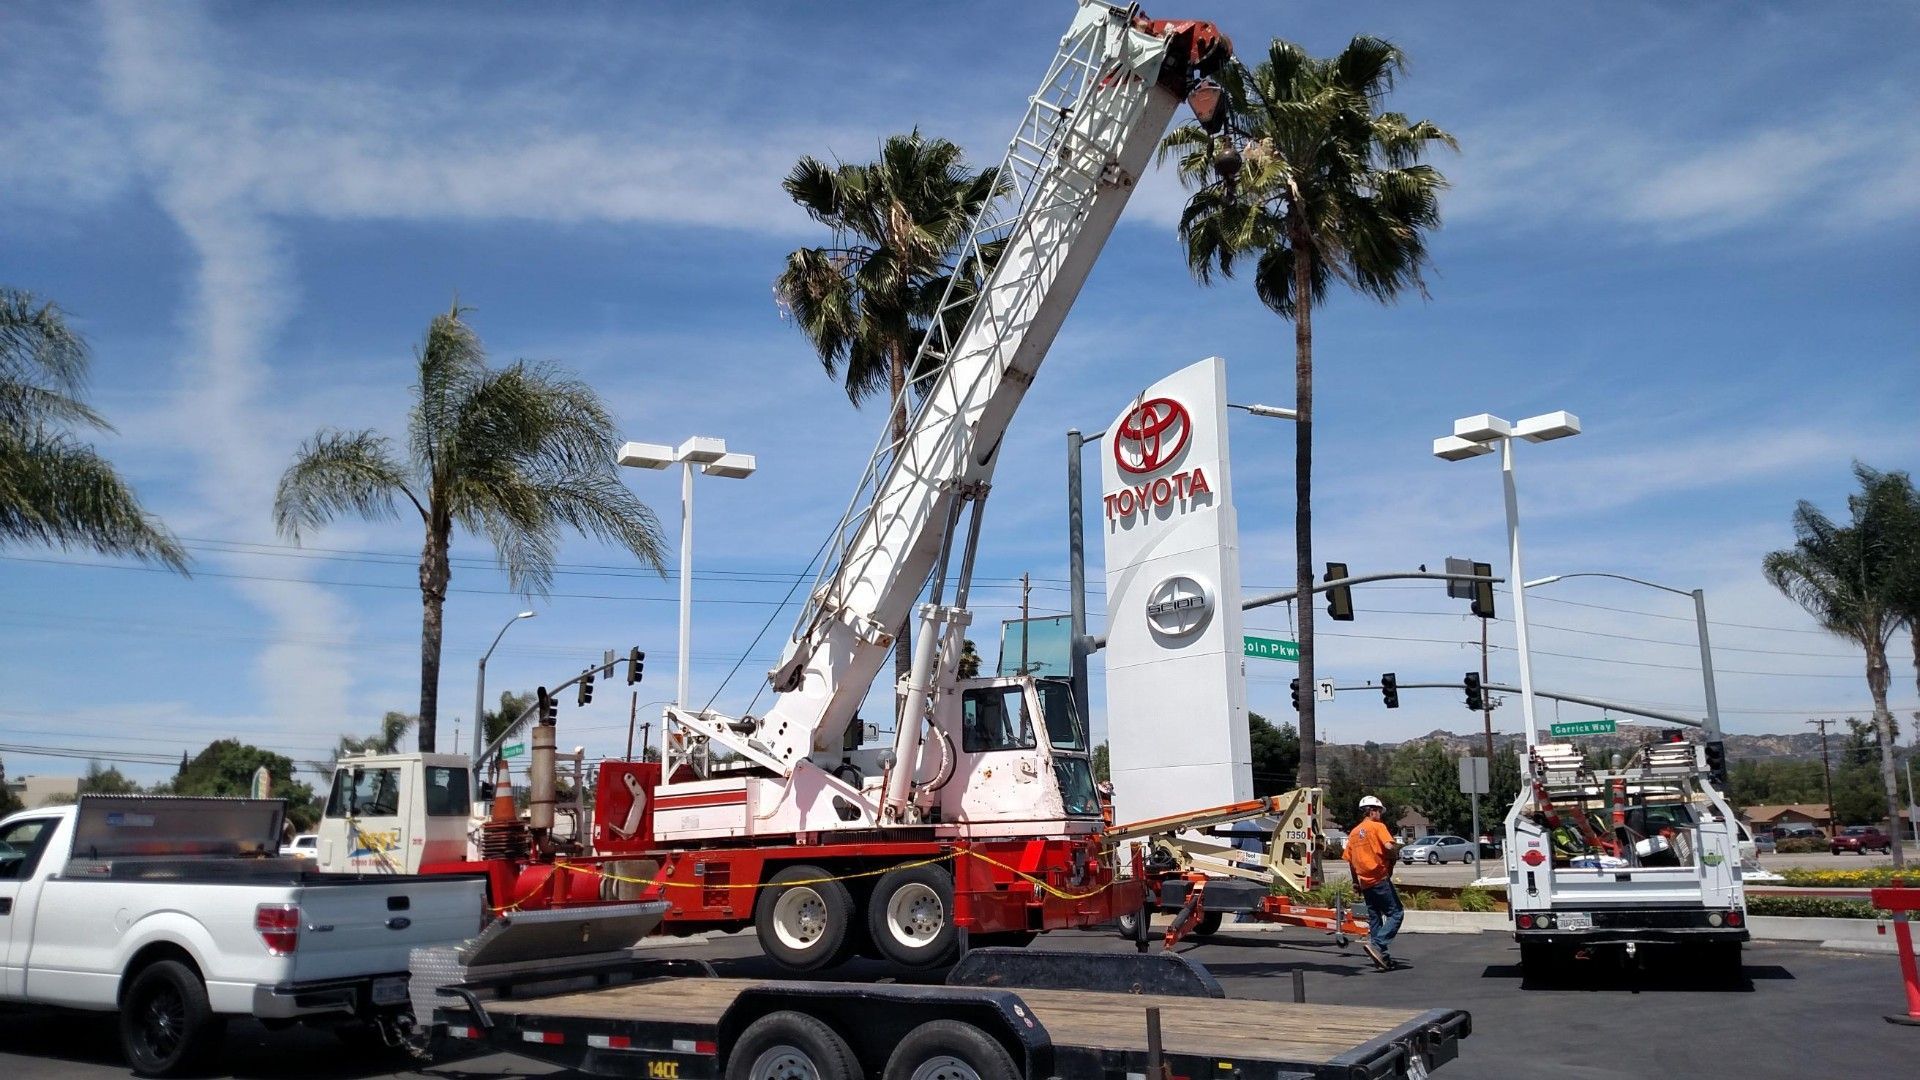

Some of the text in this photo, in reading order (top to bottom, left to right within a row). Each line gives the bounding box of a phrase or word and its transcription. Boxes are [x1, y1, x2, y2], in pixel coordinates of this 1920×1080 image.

[1103, 468, 1209, 520] TOYOTA
[1555, 723, 1611, 734] Garrick Way
[1286, 830, 1307, 840] T350
[648, 1061, 679, 1078] 14CC
